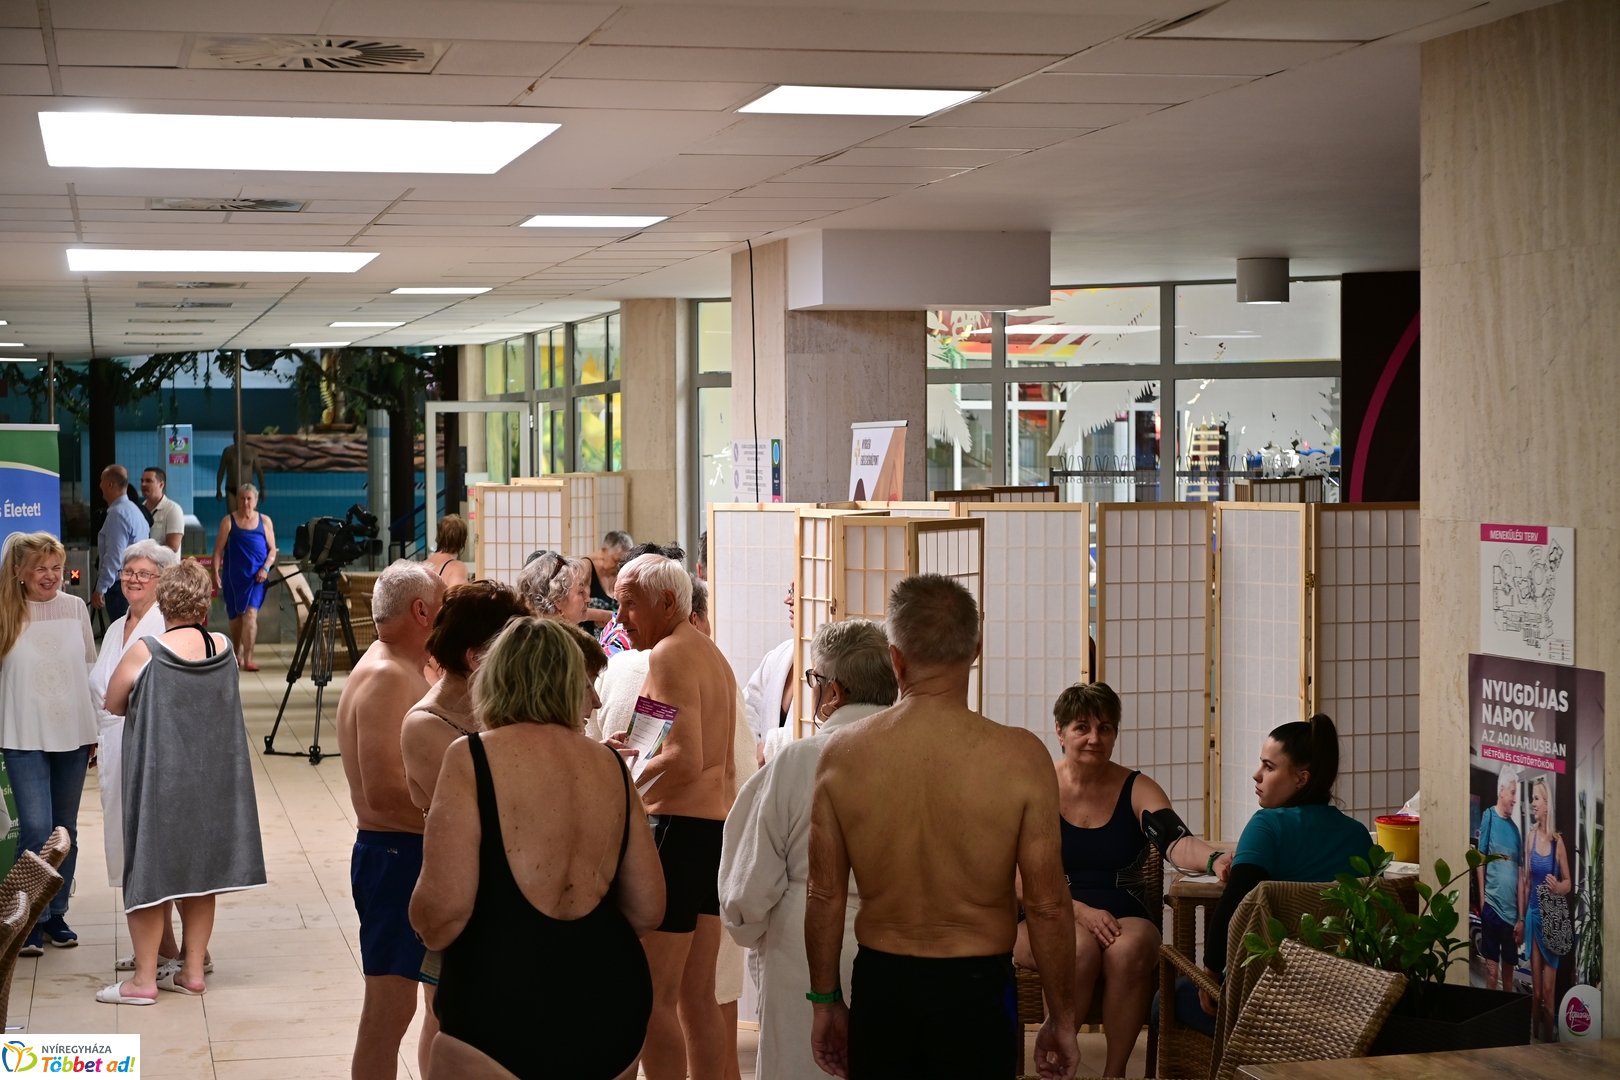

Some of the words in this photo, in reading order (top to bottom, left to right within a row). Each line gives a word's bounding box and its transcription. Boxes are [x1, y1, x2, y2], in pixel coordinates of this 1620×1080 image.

[4, 499, 41, 518] Életet!
[1524, 531, 1539, 542] TERV
[1482, 678, 1569, 713] NYUGDÍJAS
[1482, 703, 1535, 733] NAPOK
[1482, 729, 1495, 743] AZ
[1497, 731, 1567, 757] AQUARIUSBAN
[1483, 747, 1505, 760] HÉTFŐN
[1505, 751, 1512, 762] ÉS
[1512, 754, 1555, 770] CSÜTÖRTÖKÖN
